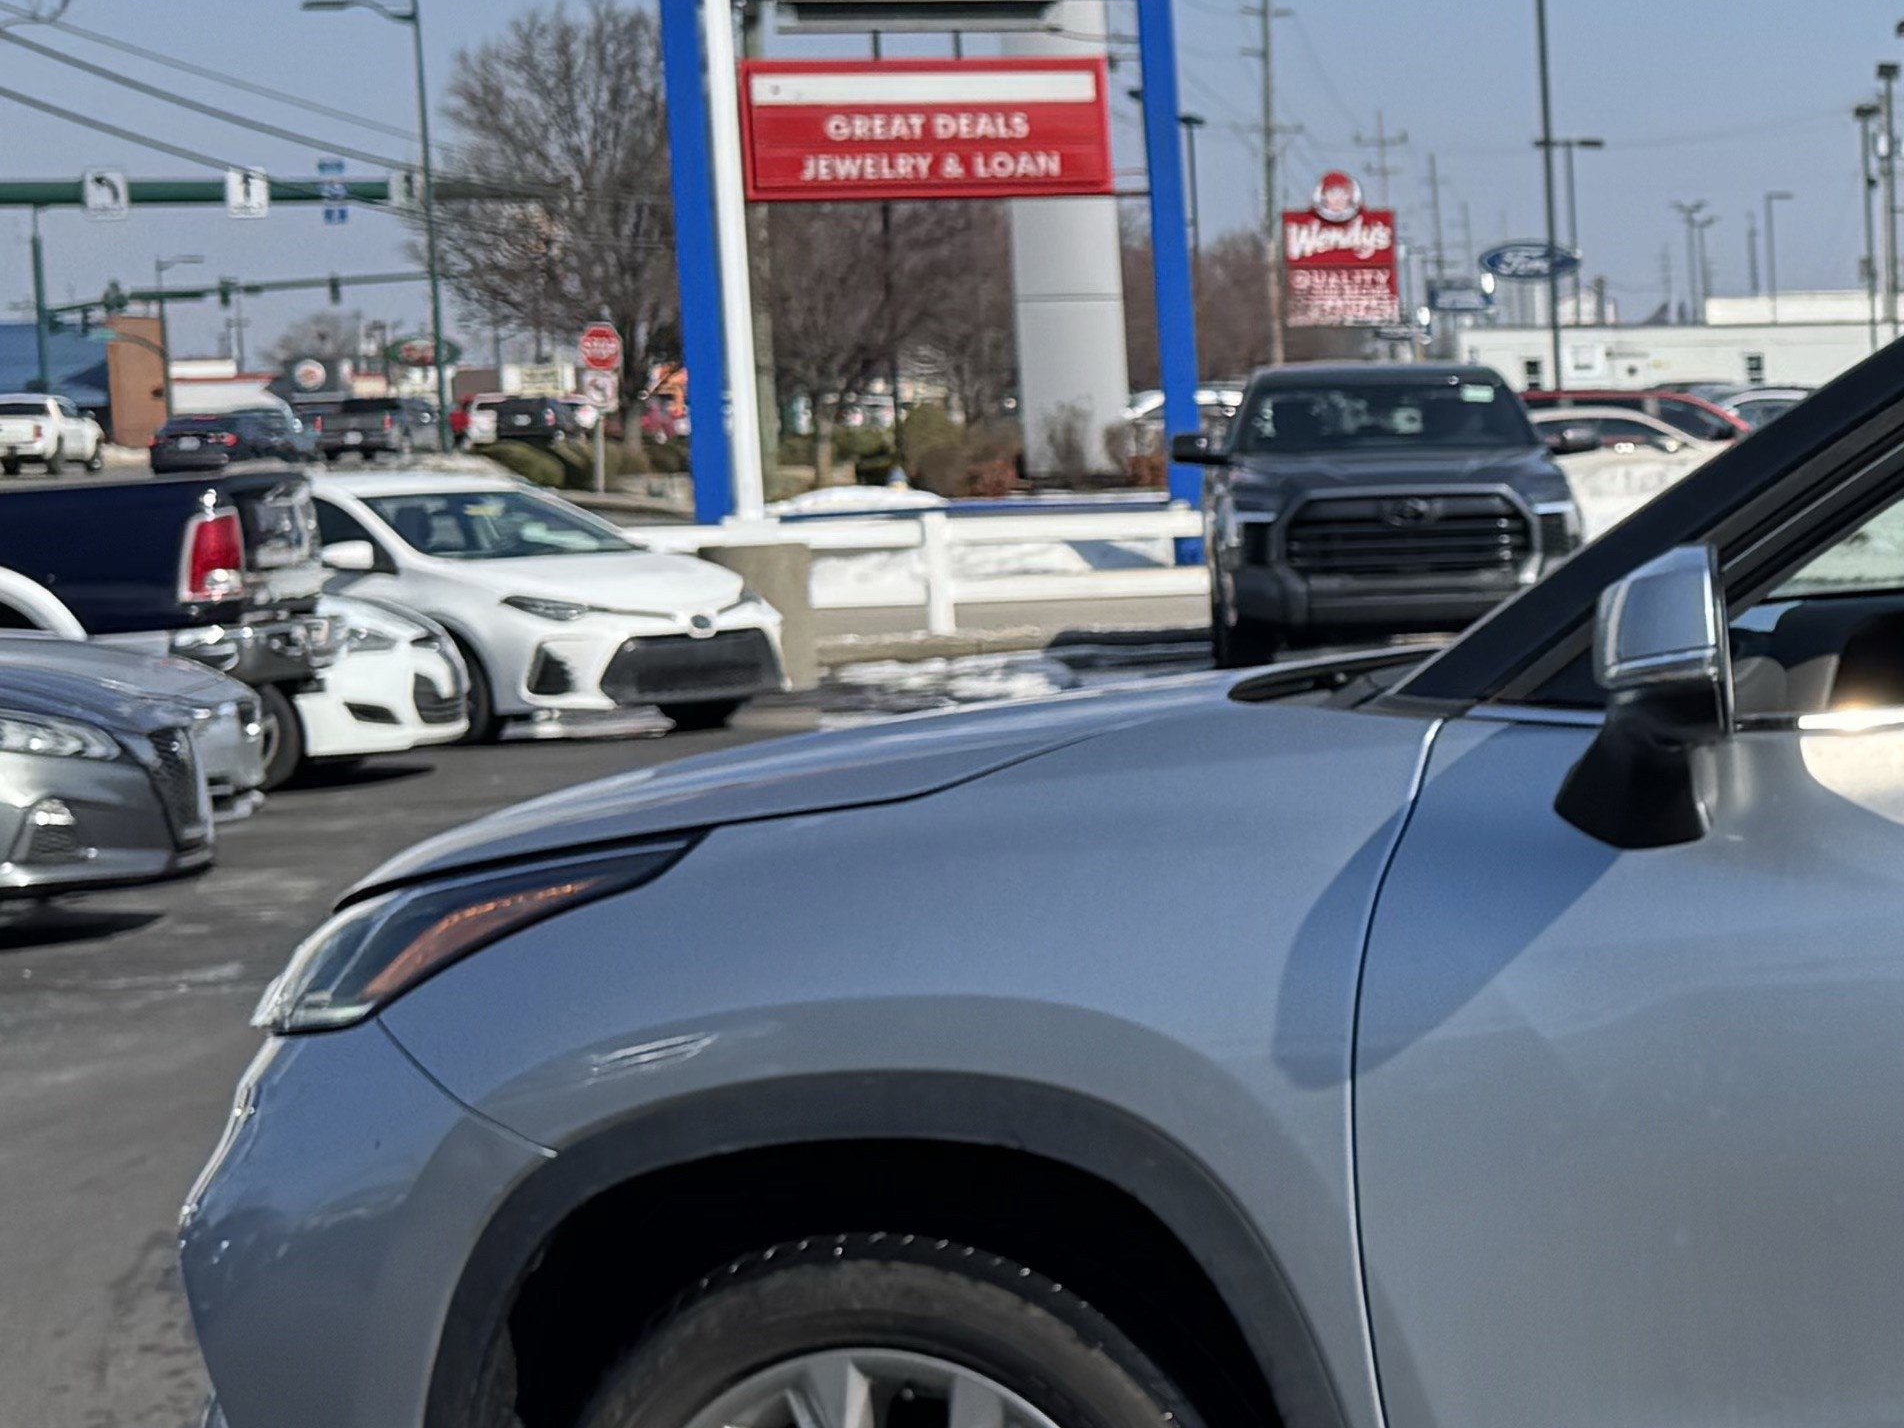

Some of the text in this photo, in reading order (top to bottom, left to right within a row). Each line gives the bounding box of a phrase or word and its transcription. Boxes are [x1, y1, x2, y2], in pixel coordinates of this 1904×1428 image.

[823, 112, 1031, 142] GREAT DEALS
[800, 150, 1062, 182] JEWELRY & LOAN
[1286, 215, 1392, 260] Wendy's
